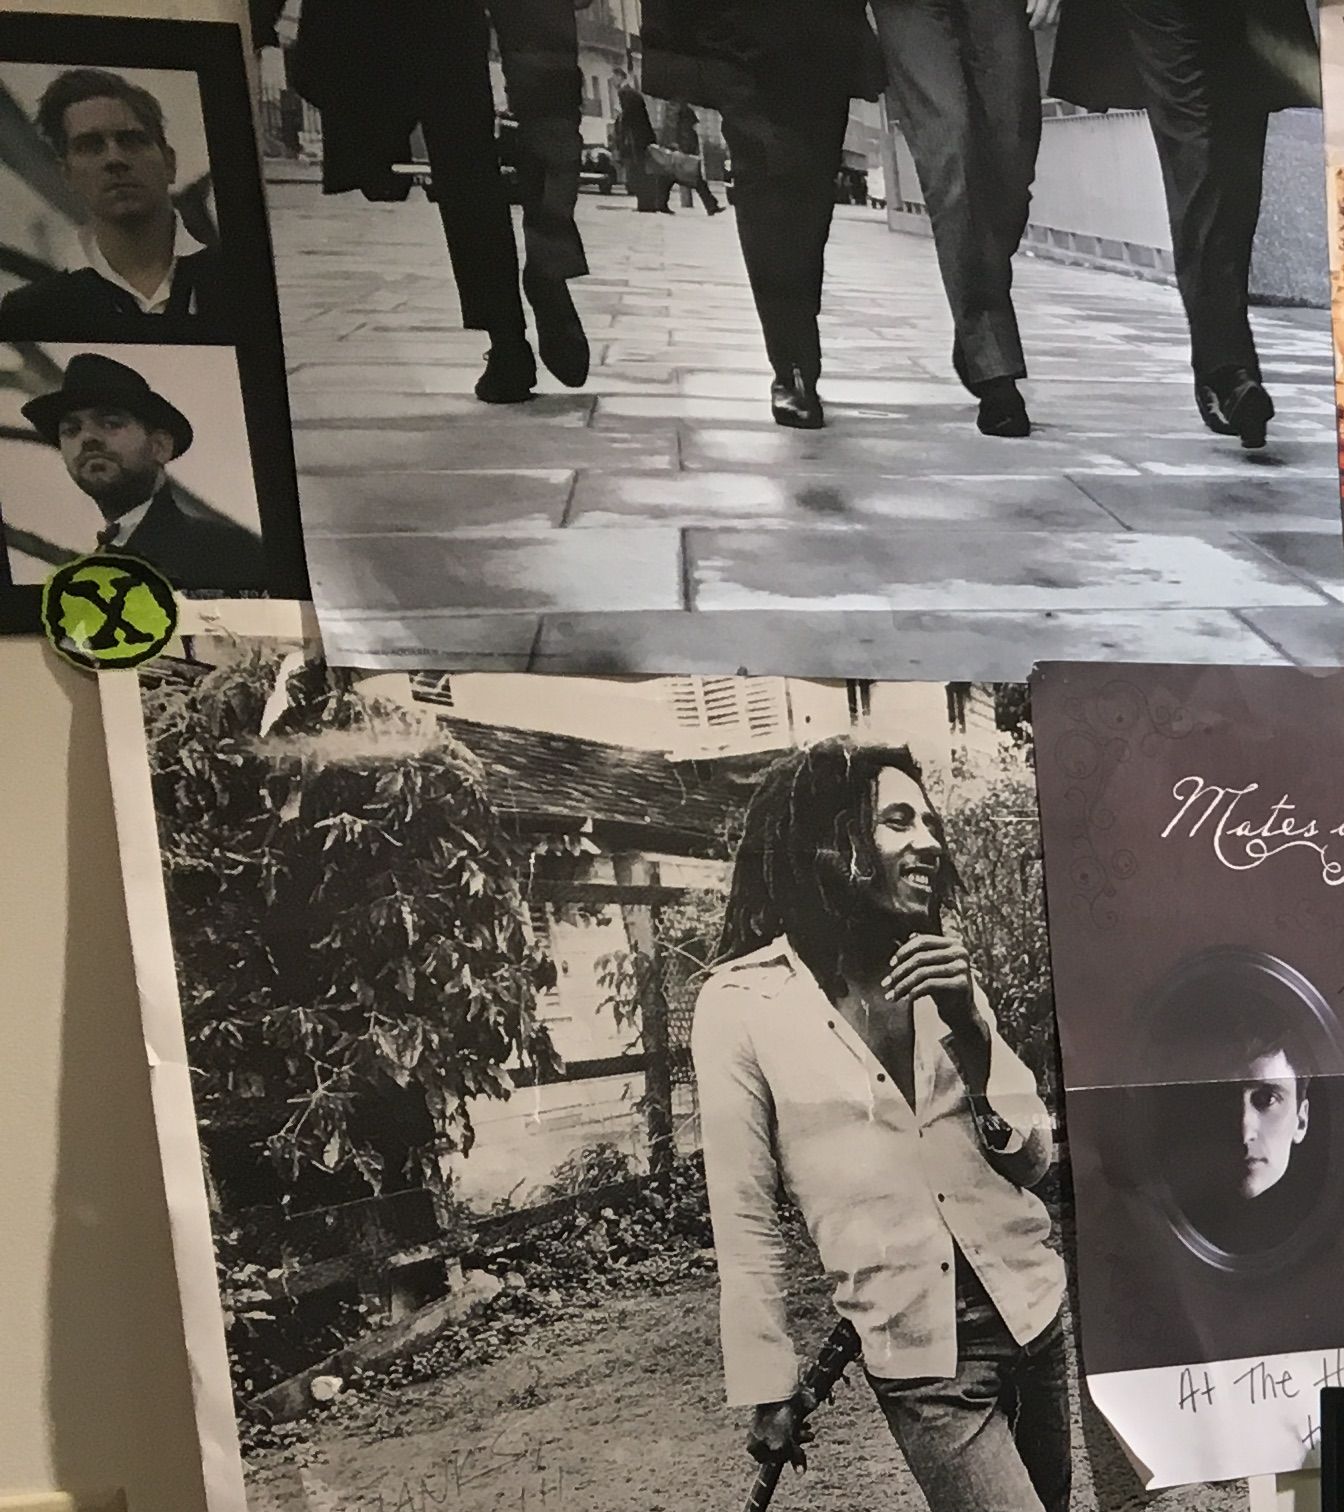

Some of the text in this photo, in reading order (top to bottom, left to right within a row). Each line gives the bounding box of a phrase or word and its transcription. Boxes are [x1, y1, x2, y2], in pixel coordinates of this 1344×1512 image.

[1161, 776, 1325, 870] Mates
[1178, 1368, 1216, 1412] At
[1234, 1361, 1300, 1405] The
